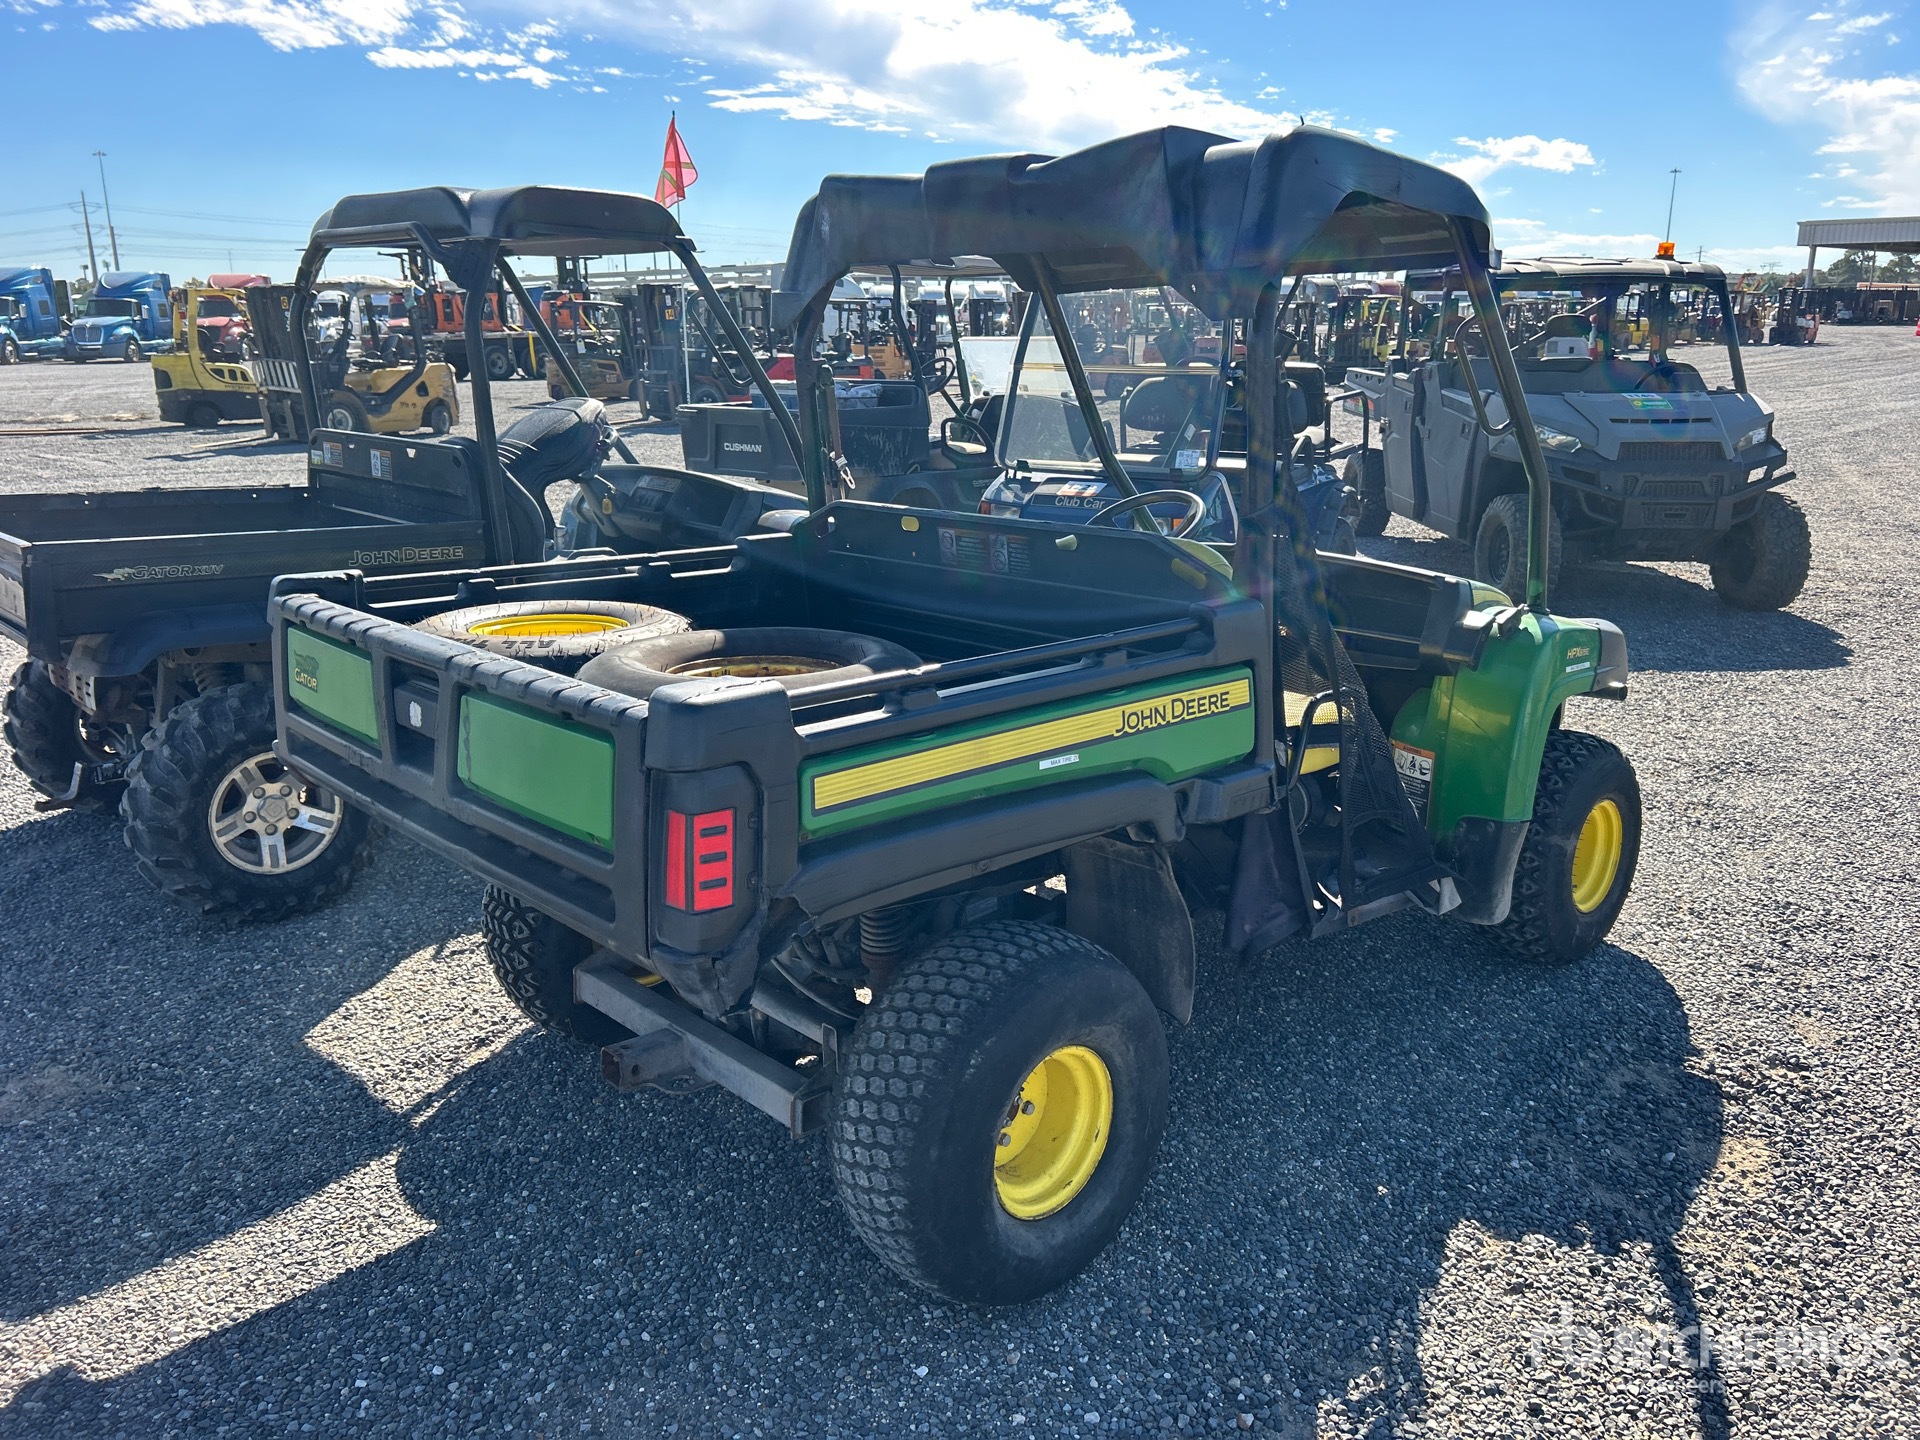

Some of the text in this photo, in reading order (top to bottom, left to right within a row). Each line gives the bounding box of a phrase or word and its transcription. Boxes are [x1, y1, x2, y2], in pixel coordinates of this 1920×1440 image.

[723, 442, 762, 453] CUSHMAN
[1055, 496, 1106, 509] Club Car
[349, 546, 464, 567] JOHN DEERE
[132, 564, 224, 580] GATOR XUV
[294, 667, 318, 692] GATOR
[1115, 691, 1230, 734] JOHN DEERE
[1050, 758, 1061, 766] MAX
[1061, 756, 1073, 764] TIRE
